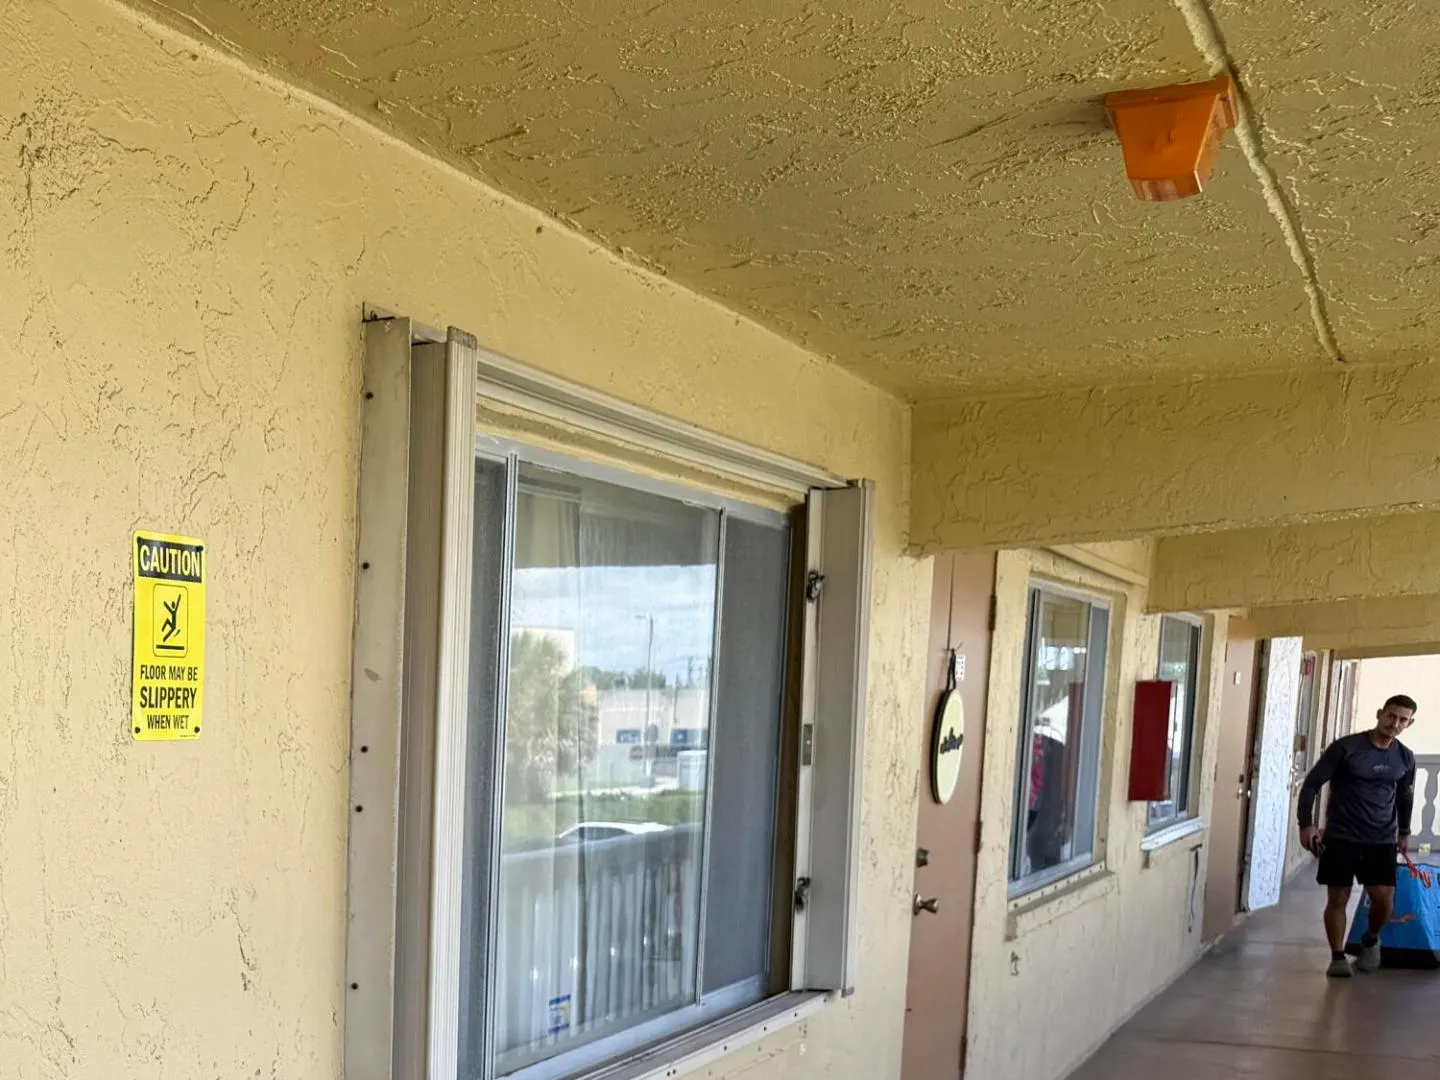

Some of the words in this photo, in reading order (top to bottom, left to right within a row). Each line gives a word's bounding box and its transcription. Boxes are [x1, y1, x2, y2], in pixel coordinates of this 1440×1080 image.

[139, 545, 200, 577] CAUTION
[140, 664, 166, 680] FLOOR
[168, 665, 185, 680] MAY
[188, 666, 198, 681] BE
[139, 686, 197, 709] SLIPPERY
[147, 714, 171, 729] WHEN
[173, 714, 189, 729] WET
